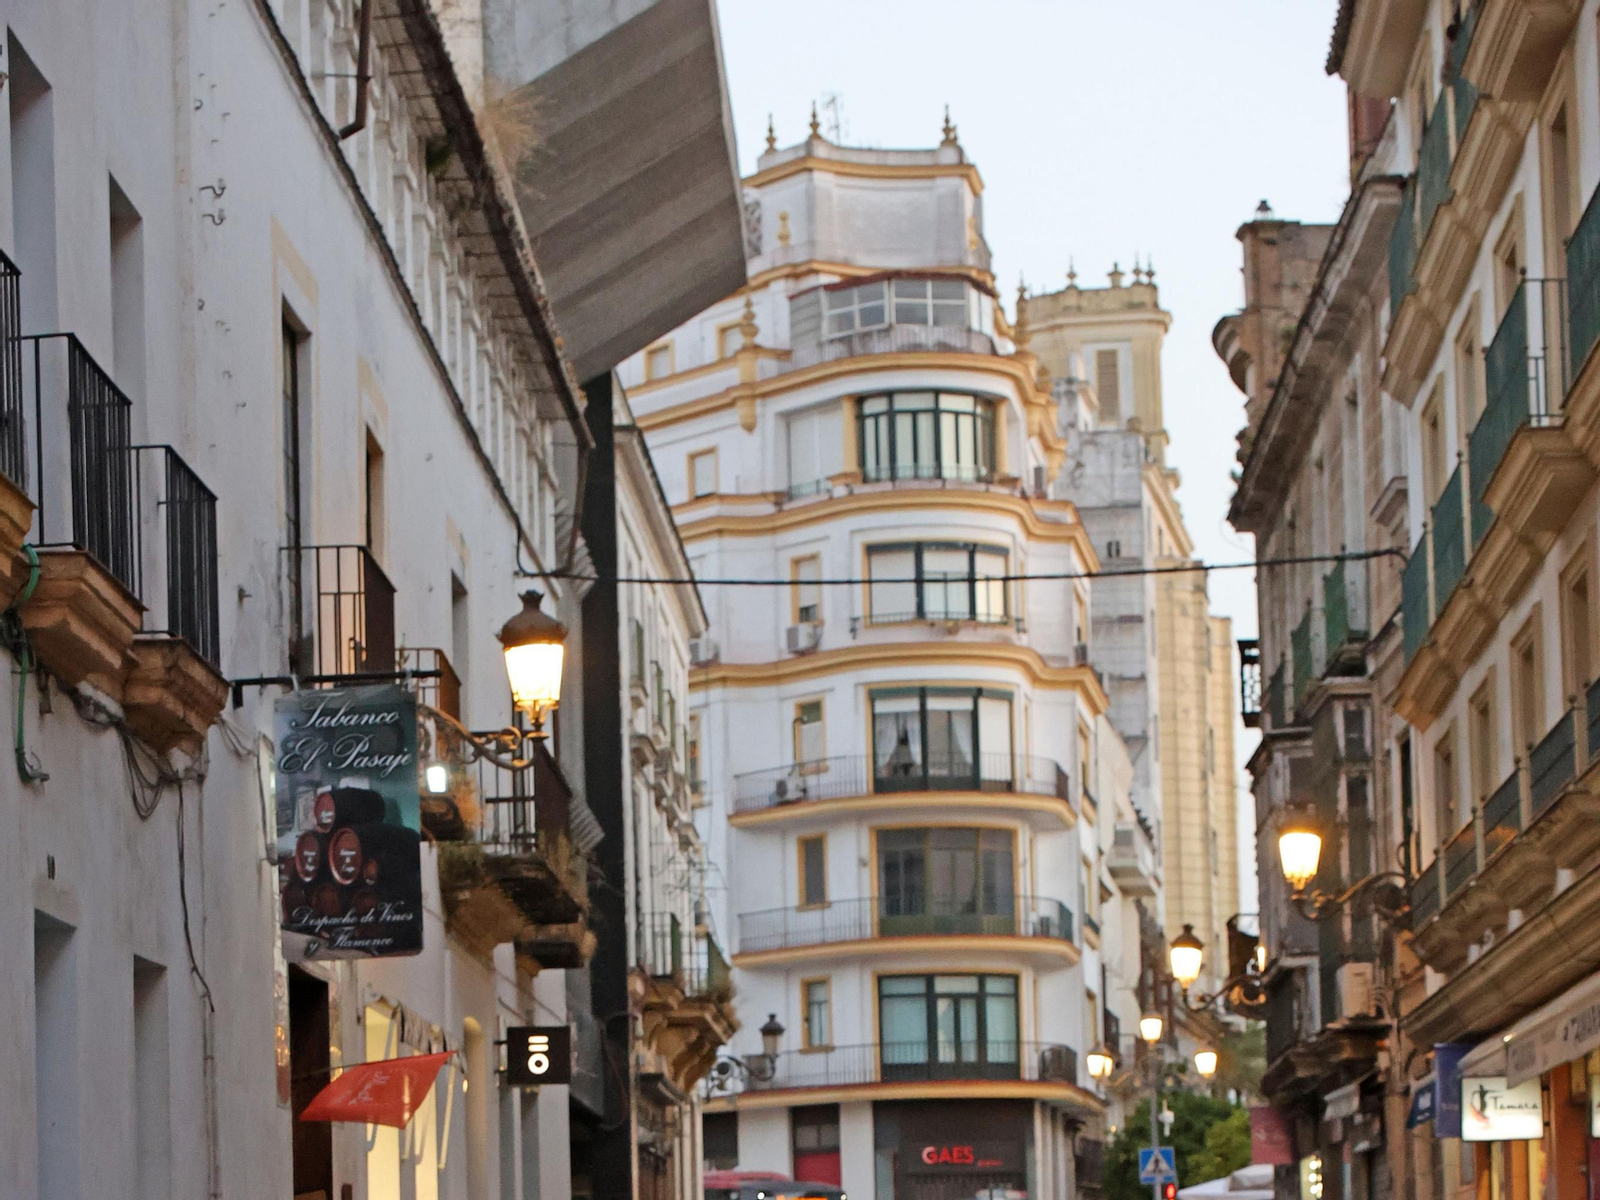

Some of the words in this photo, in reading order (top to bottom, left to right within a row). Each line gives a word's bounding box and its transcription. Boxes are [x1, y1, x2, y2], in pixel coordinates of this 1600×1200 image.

[291, 690, 399, 728] Tabanco
[279, 735, 329, 774] El
[327, 732, 412, 778] Pasaje
[292, 903, 358, 932] Despacho
[360, 908, 375, 923] de
[377, 901, 414, 923] Vinos
[330, 926, 394, 948] Flamenco
[921, 1145, 975, 1166] GAES
